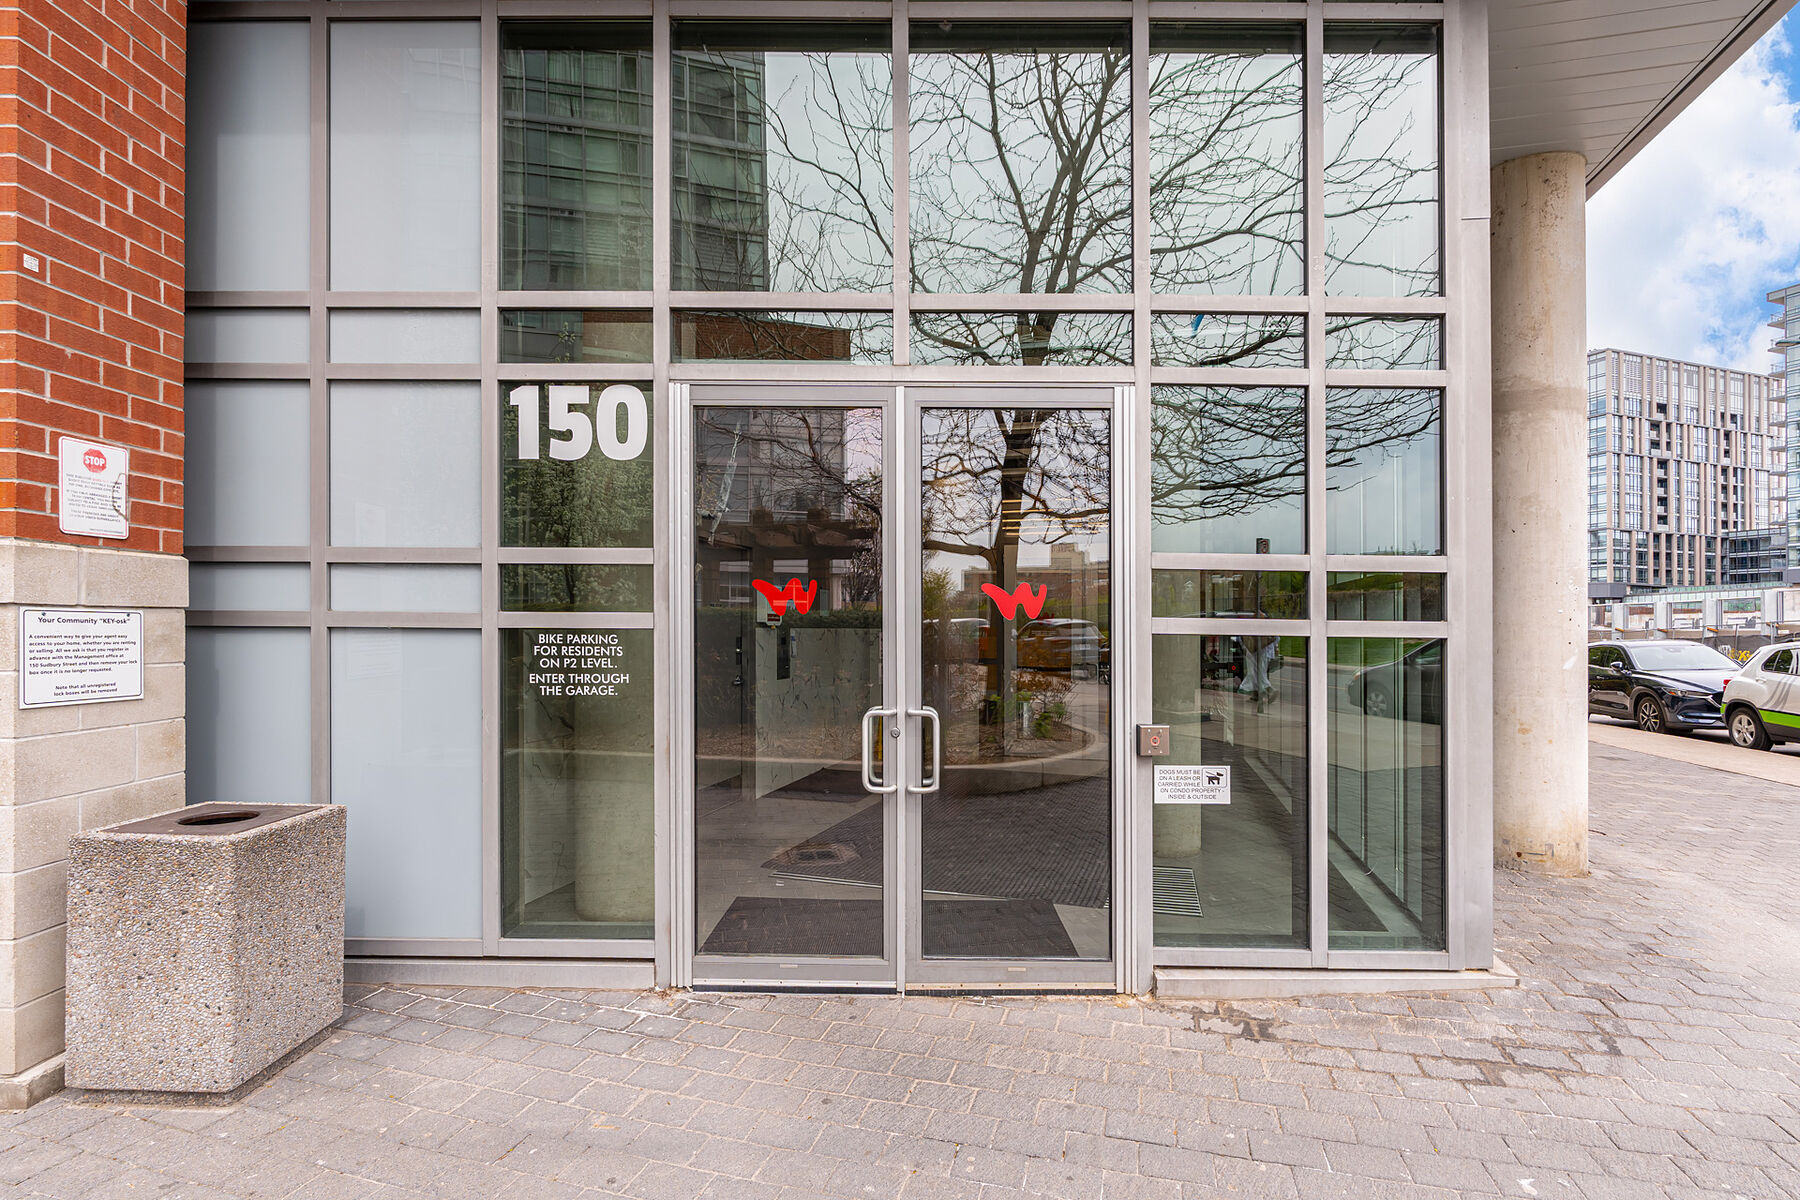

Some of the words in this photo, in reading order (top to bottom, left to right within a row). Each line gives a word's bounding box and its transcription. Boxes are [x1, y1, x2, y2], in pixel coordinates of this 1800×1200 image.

[510, 384, 648, 460] 150
[84, 456, 106, 466] STOP
[538, 634, 563, 644] BIKE
[567, 634, 619, 644] PARKING
[534, 646, 558, 656] FOR
[562, 646, 623, 656] RESIDENTS
[540, 658, 560, 668] ON
[564, 658, 577, 668] P2
[582, 658, 618, 668] LEVEL.
[529, 674, 565, 683] ENTER
[568, 674, 629, 683] THROUGH
[540, 686, 562, 695] THE
[566, 686, 618, 696] GARAGE.
